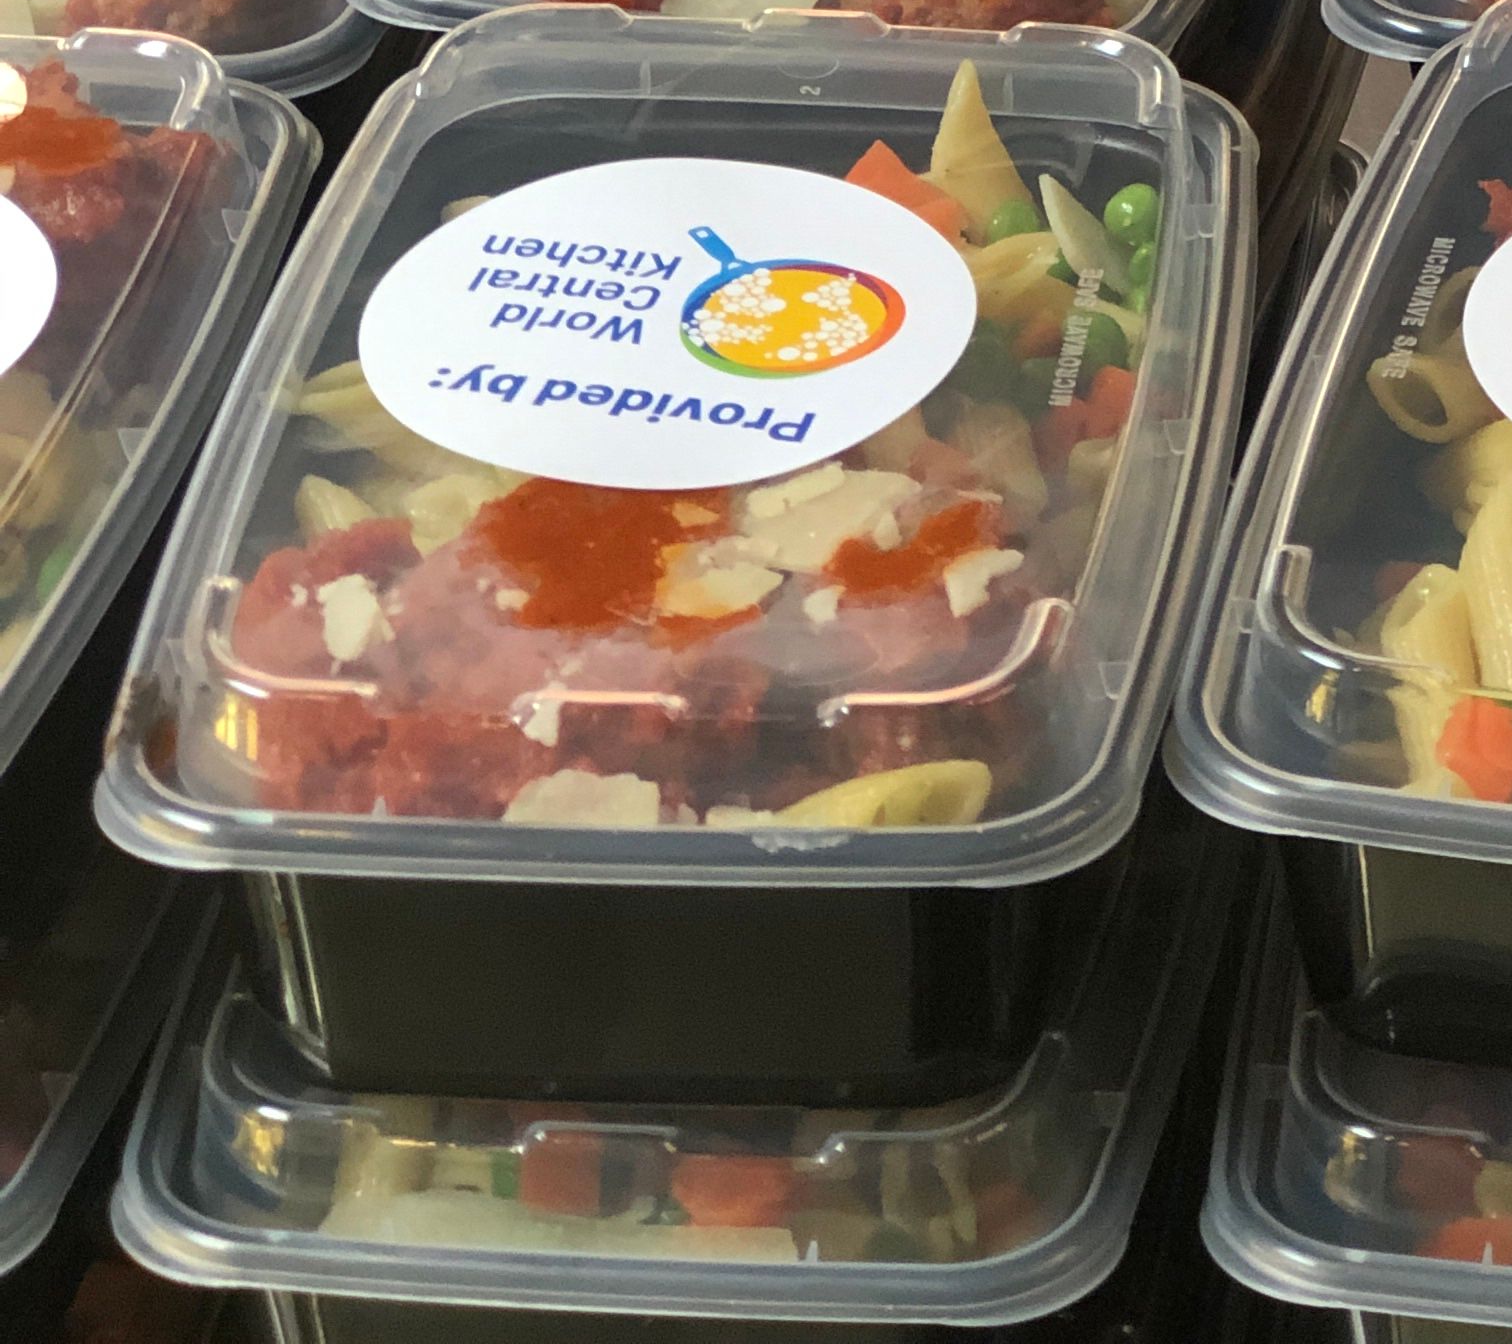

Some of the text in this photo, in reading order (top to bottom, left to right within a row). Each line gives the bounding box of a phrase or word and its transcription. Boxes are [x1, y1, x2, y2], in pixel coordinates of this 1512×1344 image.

[481, 233, 683, 281] Kitchen
[467, 266, 663, 313] Central
[1381, 237, 1456, 379] MICROWAVE SAFE
[490, 301, 645, 346] World
[1047, 267, 1105, 407] MICROWAVE SAFE
[429, 363, 818, 444] Provided by:
